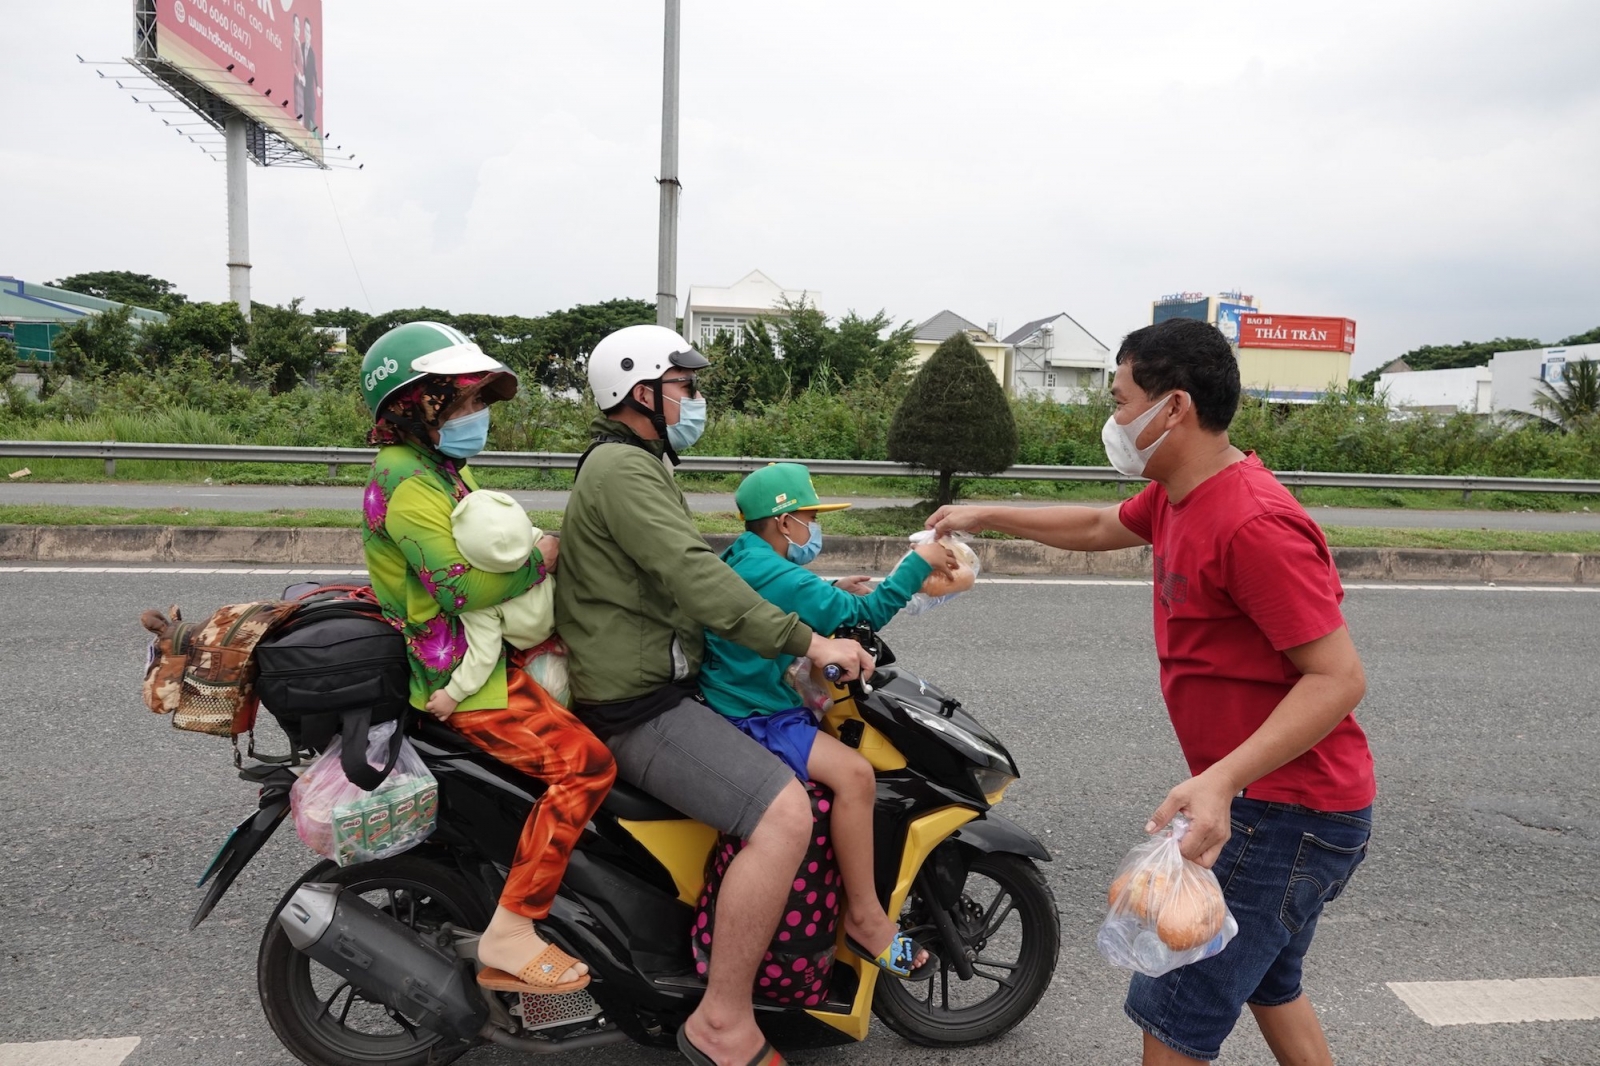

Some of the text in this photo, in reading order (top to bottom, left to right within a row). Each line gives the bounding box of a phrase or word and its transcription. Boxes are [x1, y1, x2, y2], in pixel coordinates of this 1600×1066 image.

[209, 6, 229, 31] 6060
[230, 20, 252, 50] (24/7)
[249, 14, 263, 34] cao
[188, 15, 256, 74] www.hdbank.com.vn
[1246, 316, 1273, 325] BAO BÌ
[1255, 324, 1288, 339] THÁI
[1291, 327, 1328, 341] TRÂN
[364, 356, 398, 392] Grab
